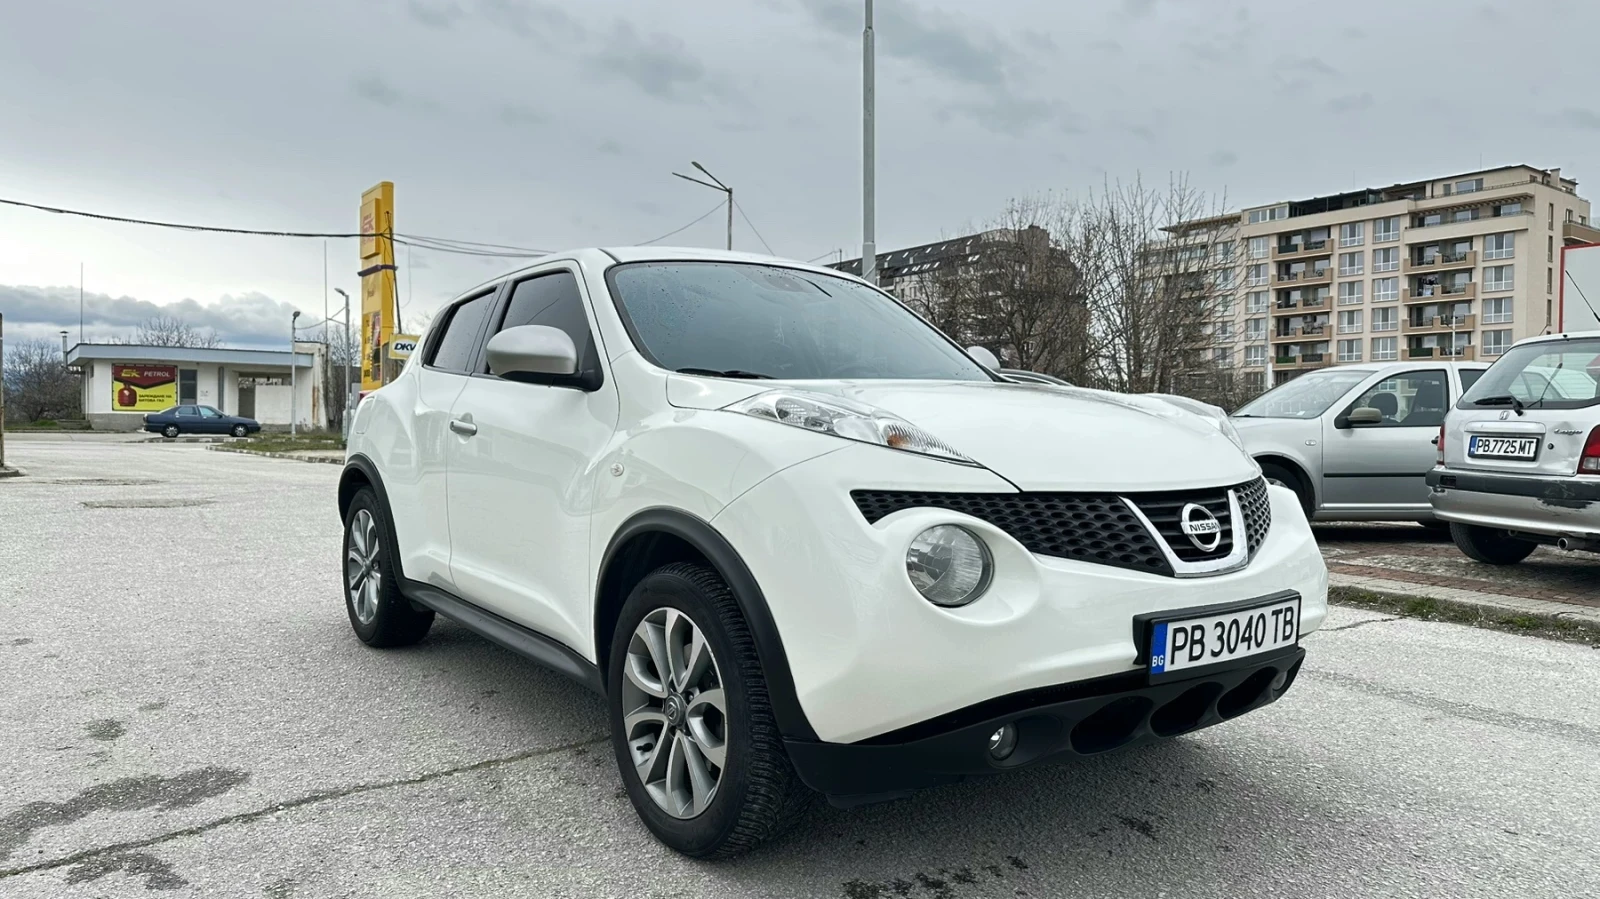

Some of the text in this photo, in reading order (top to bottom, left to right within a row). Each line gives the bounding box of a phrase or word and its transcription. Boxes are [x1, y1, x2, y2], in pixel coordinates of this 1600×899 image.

[394, 342, 416, 351] DKV
[1491, 439, 1517, 454] 7725
[1518, 440, 1534, 455] MT
[1189, 522, 1220, 532] NISSAN
[1170, 606, 1294, 665] PB 3040 TB
[1152, 654, 1165, 667] BG
